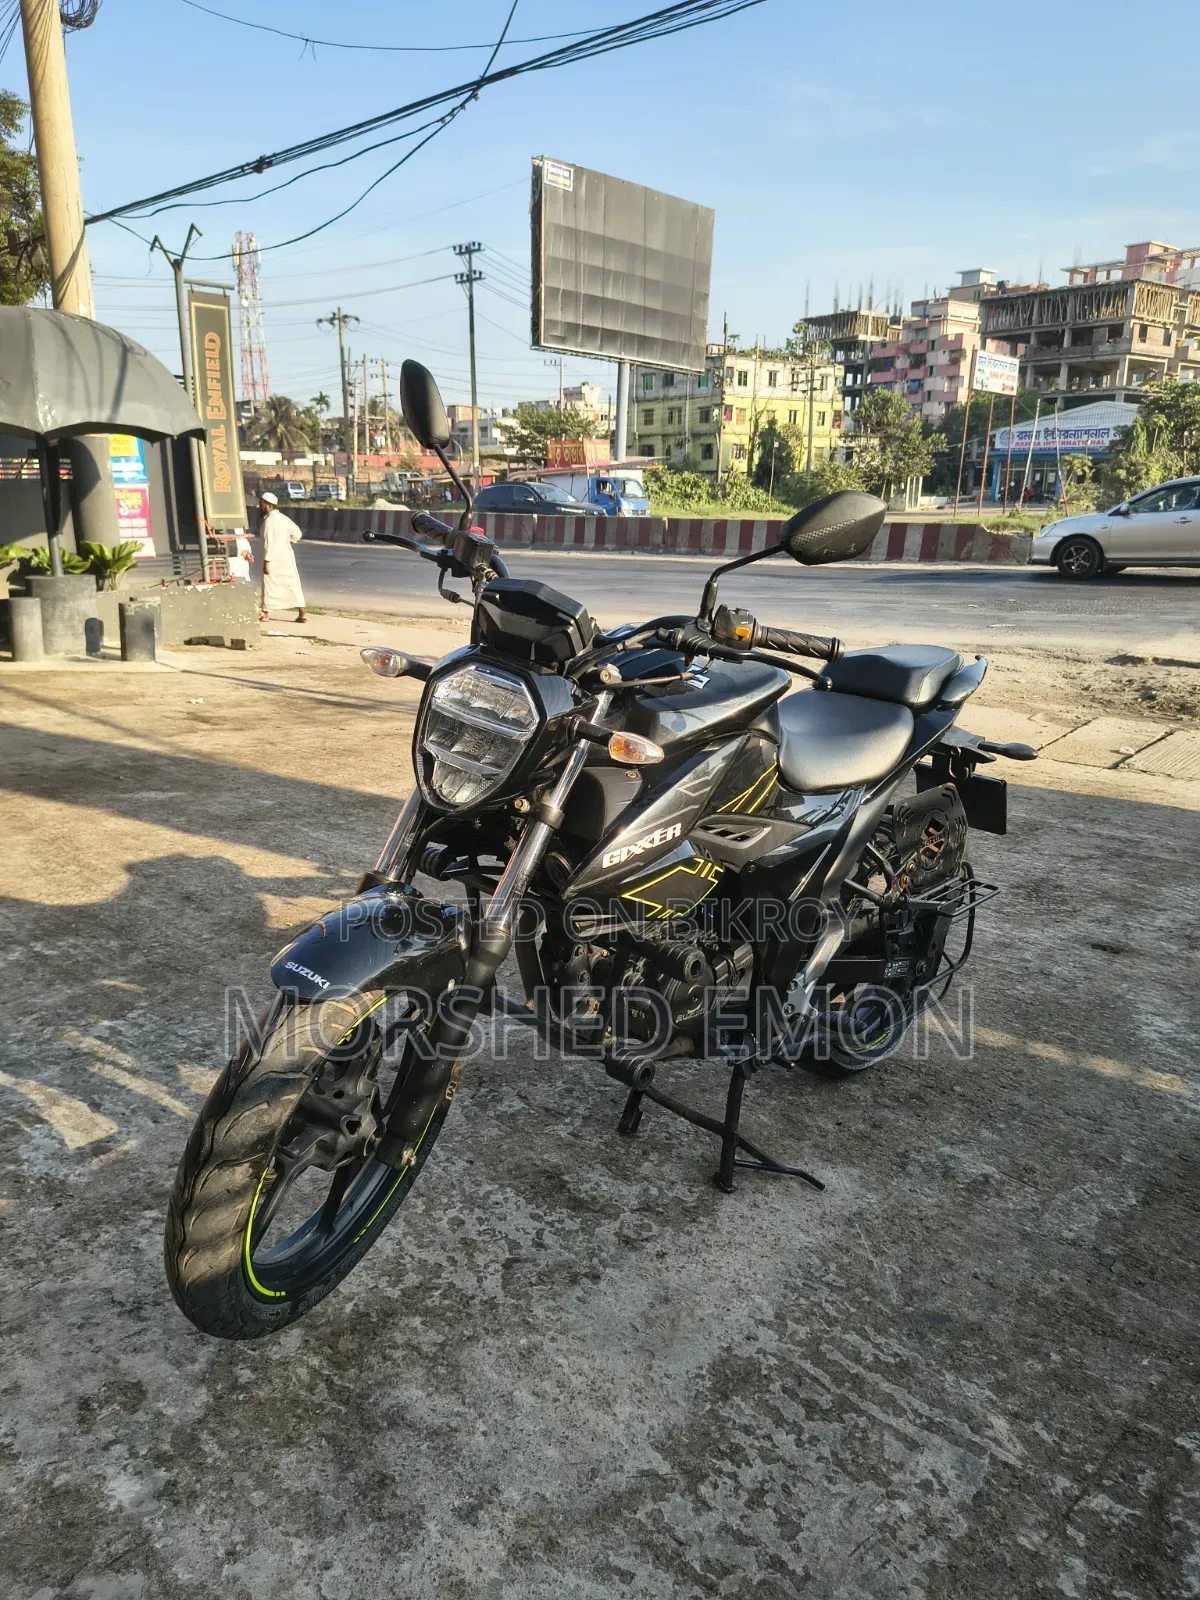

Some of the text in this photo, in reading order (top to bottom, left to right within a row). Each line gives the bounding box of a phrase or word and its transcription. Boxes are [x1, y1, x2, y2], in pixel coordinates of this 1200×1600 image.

[205, 332, 231, 493] ROYAL ENFIELD
[602, 823, 682, 869] GIXXER
[285, 961, 331, 989] SUZUKI
